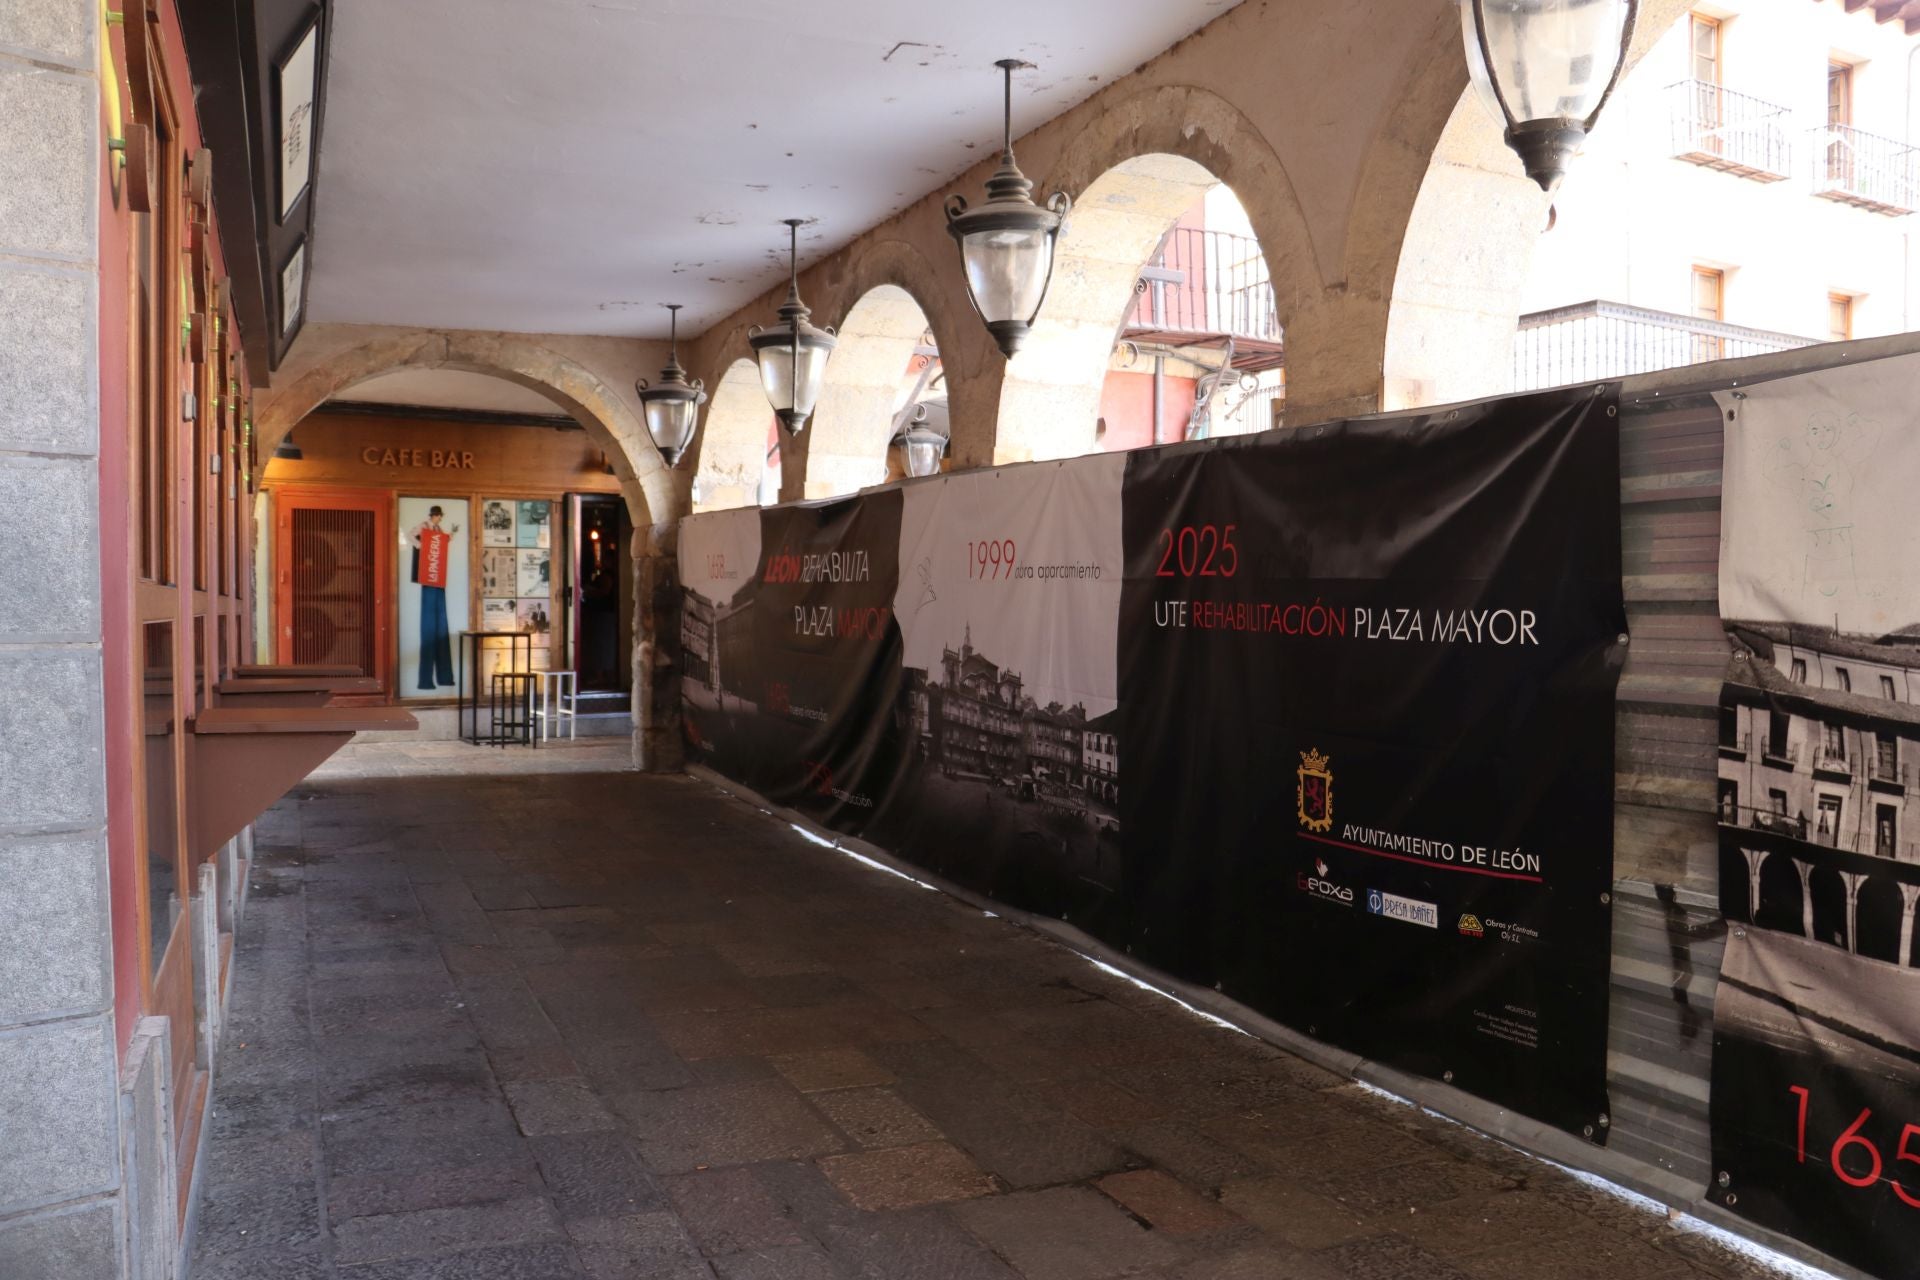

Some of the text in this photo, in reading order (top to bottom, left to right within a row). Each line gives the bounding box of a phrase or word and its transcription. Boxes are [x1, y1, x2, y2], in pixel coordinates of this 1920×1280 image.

[362, 447, 475, 470] CAFE BAR
[764, 545, 870, 584] LEÓN REHABILITA
[968, 539, 1016, 580] 1999
[1037, 561, 1101, 583] aparcamiento
[1156, 525, 1238, 577] 2025
[795, 606, 834, 637] PLAZA
[1154, 597, 1540, 645] UTE REHABILITACIÓN PLAZA MAYOR
[1342, 824, 1541, 873] AYUNTAMIENTO DE LEÓN
[1384, 897, 1408, 918] PRESA
[1485, 919, 1506, 930] Obras
[1512, 923, 1539, 938] Contratas
